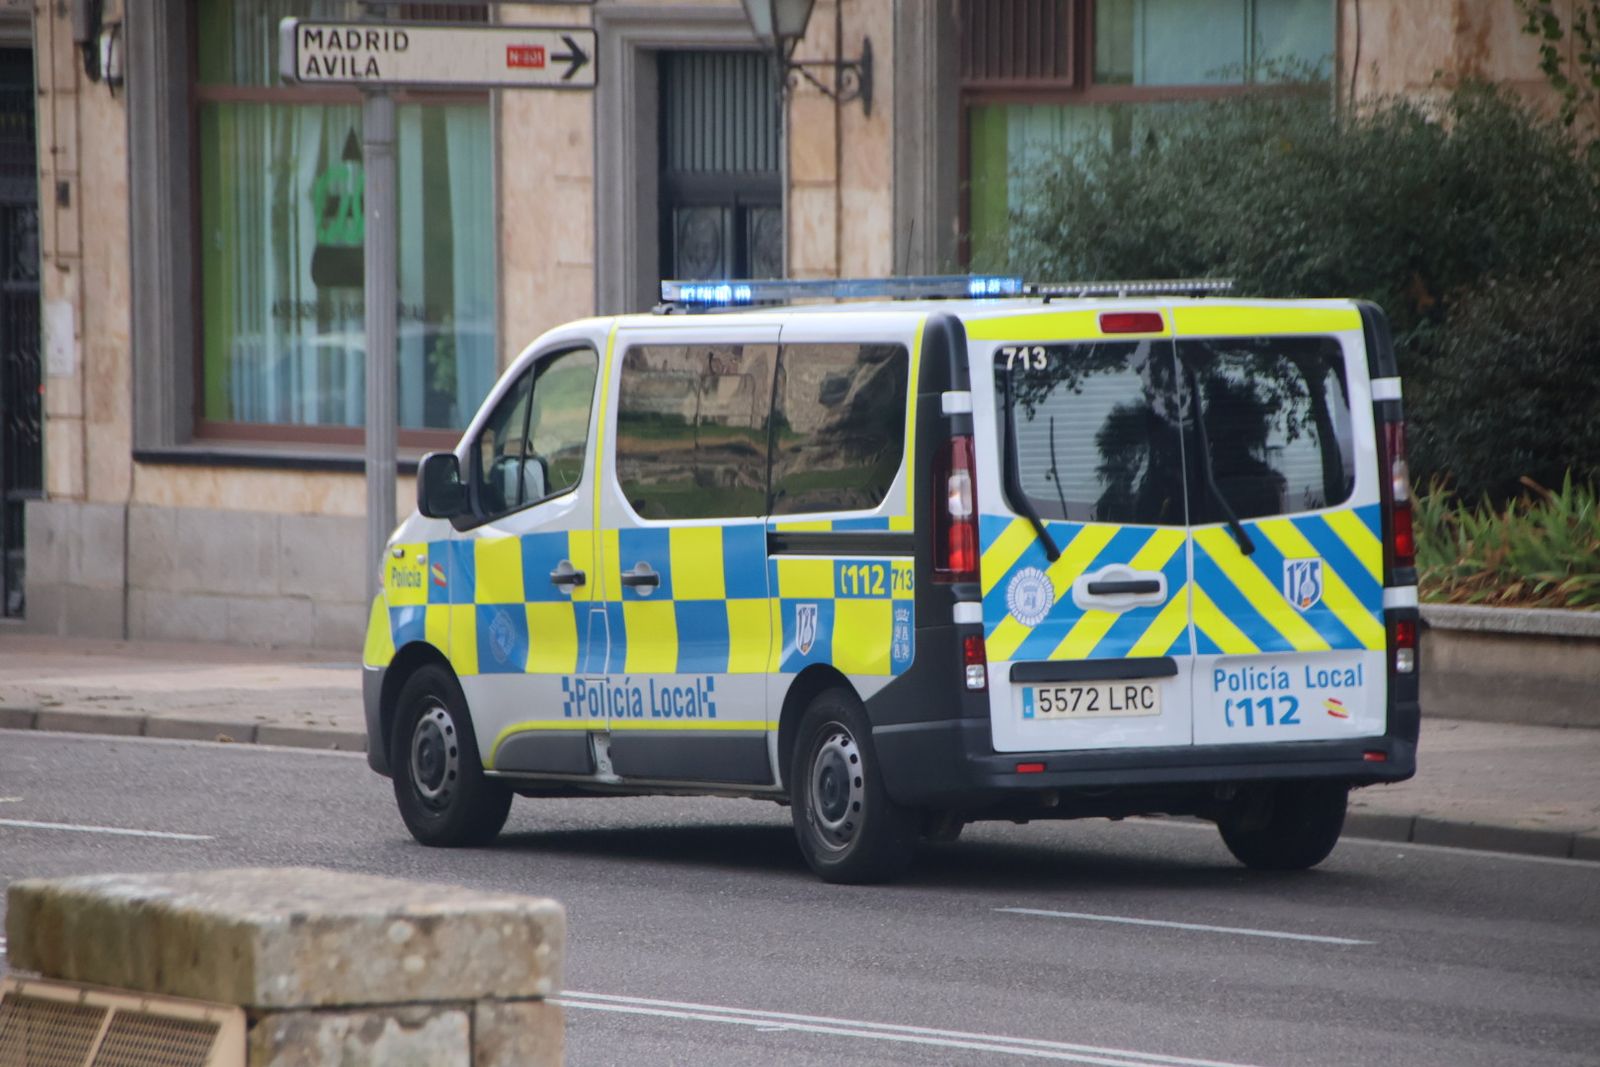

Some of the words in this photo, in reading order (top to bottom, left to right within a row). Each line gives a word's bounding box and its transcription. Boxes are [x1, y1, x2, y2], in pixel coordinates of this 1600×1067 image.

[303, 29, 409, 52] MADRID
[305, 54, 381, 77] AVILA
[1002, 346, 1048, 371] 713
[847, 564, 885, 595] 112
[891, 568, 914, 591] 713
[1213, 665, 1290, 693] Policía
[1305, 662, 1363, 689] Local
[575, 676, 644, 718] Policía
[649, 677, 703, 718] Local
[1038, 687, 1100, 713] 5572
[1109, 685, 1154, 711] LRC
[1235, 694, 1301, 727] 112
